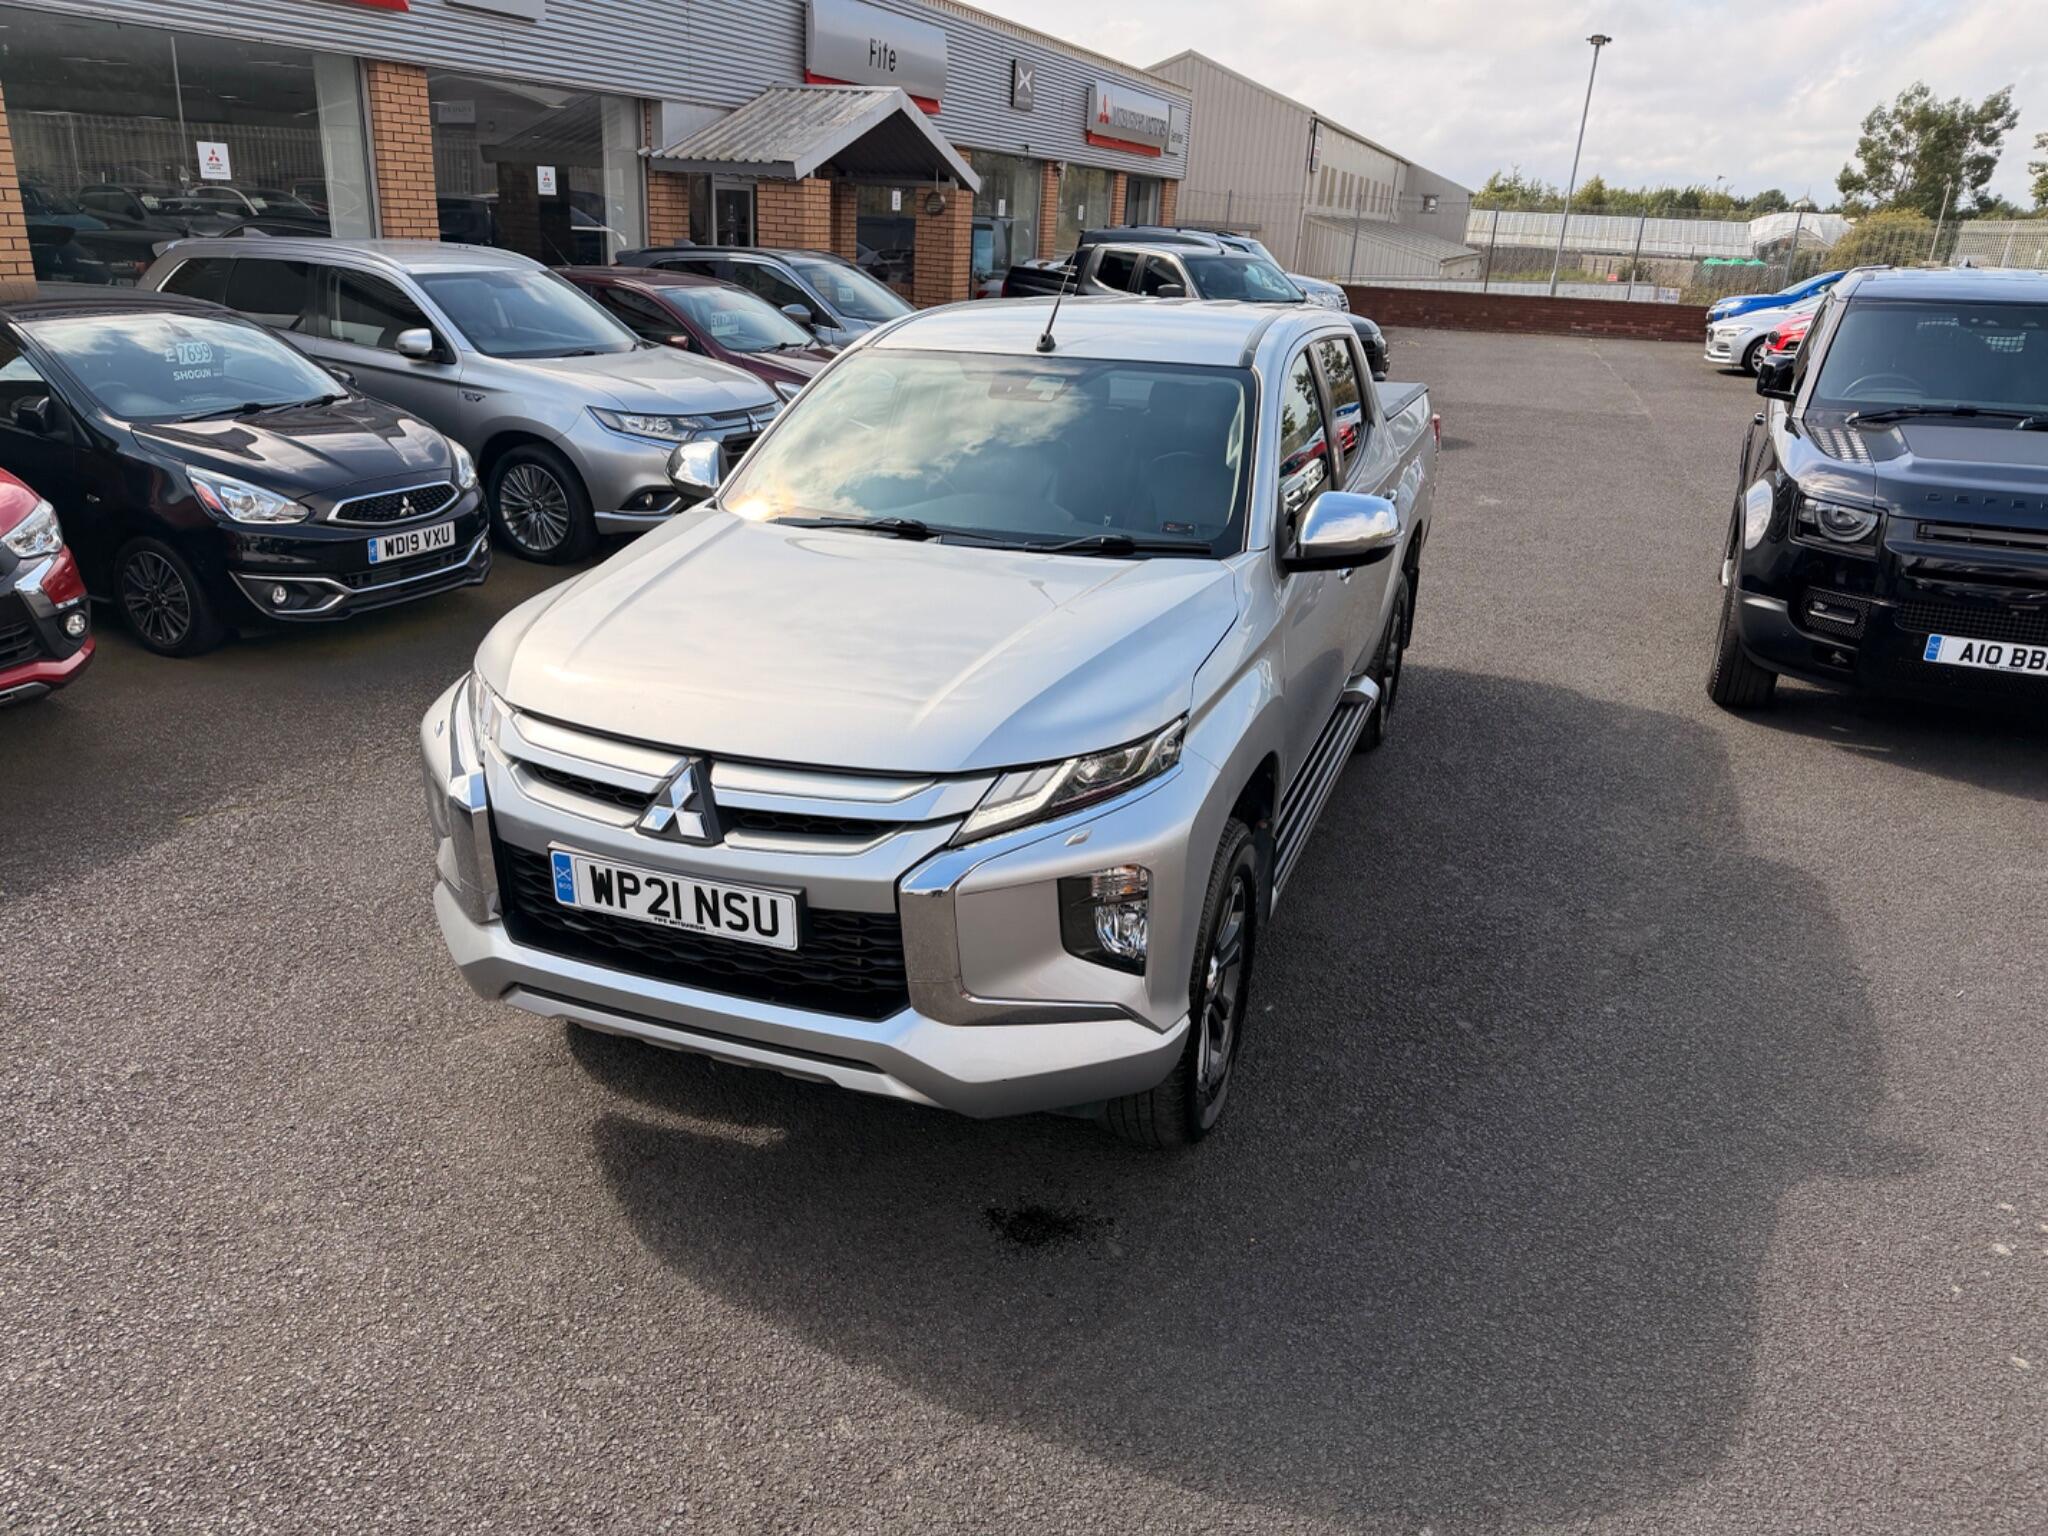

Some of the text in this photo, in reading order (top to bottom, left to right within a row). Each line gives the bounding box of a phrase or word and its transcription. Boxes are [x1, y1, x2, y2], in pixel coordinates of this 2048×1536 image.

[869, 37, 897, 73] Fife
[173, 368, 212, 381] SHOGUN
[384, 525, 450, 557] WD19 VXU
[1959, 642, 2003, 665] A10
[2009, 647, 2048, 672] BB
[589, 865, 780, 938] WP21 NSU
